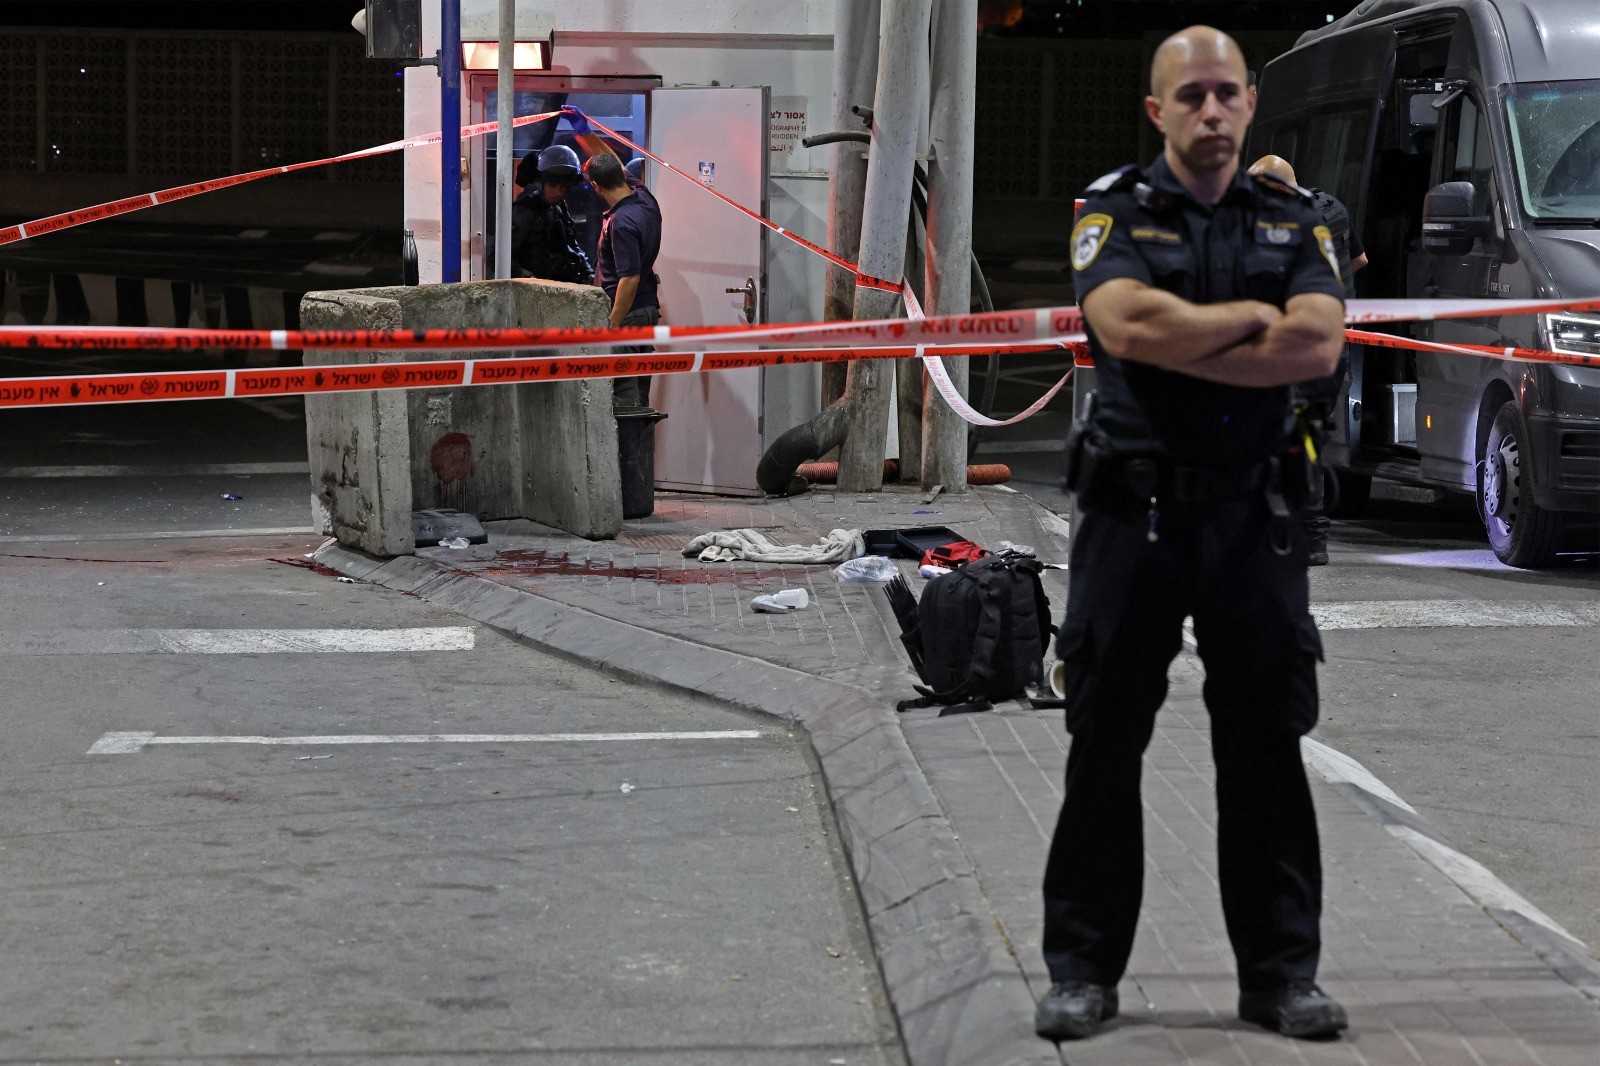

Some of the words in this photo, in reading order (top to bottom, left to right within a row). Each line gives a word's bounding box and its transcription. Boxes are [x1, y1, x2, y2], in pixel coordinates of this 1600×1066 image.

[784, 111, 805, 119] אסור
[567, 362, 608, 374] ישראל
[634, 360, 688, 371] משטרת
[332, 372, 376, 386] ישראל
[404, 368, 458, 382] משטרת
[479, 367, 517, 378] מעבר
[520, 366, 540, 379] אין
[88, 382, 134, 396] ישראל
[164, 380, 219, 393] משטרת
[241, 377, 280, 389] מעבר
[285, 376, 305, 390] אין
[0, 387, 35, 400] מעב
[40, 386, 60, 401] אין
